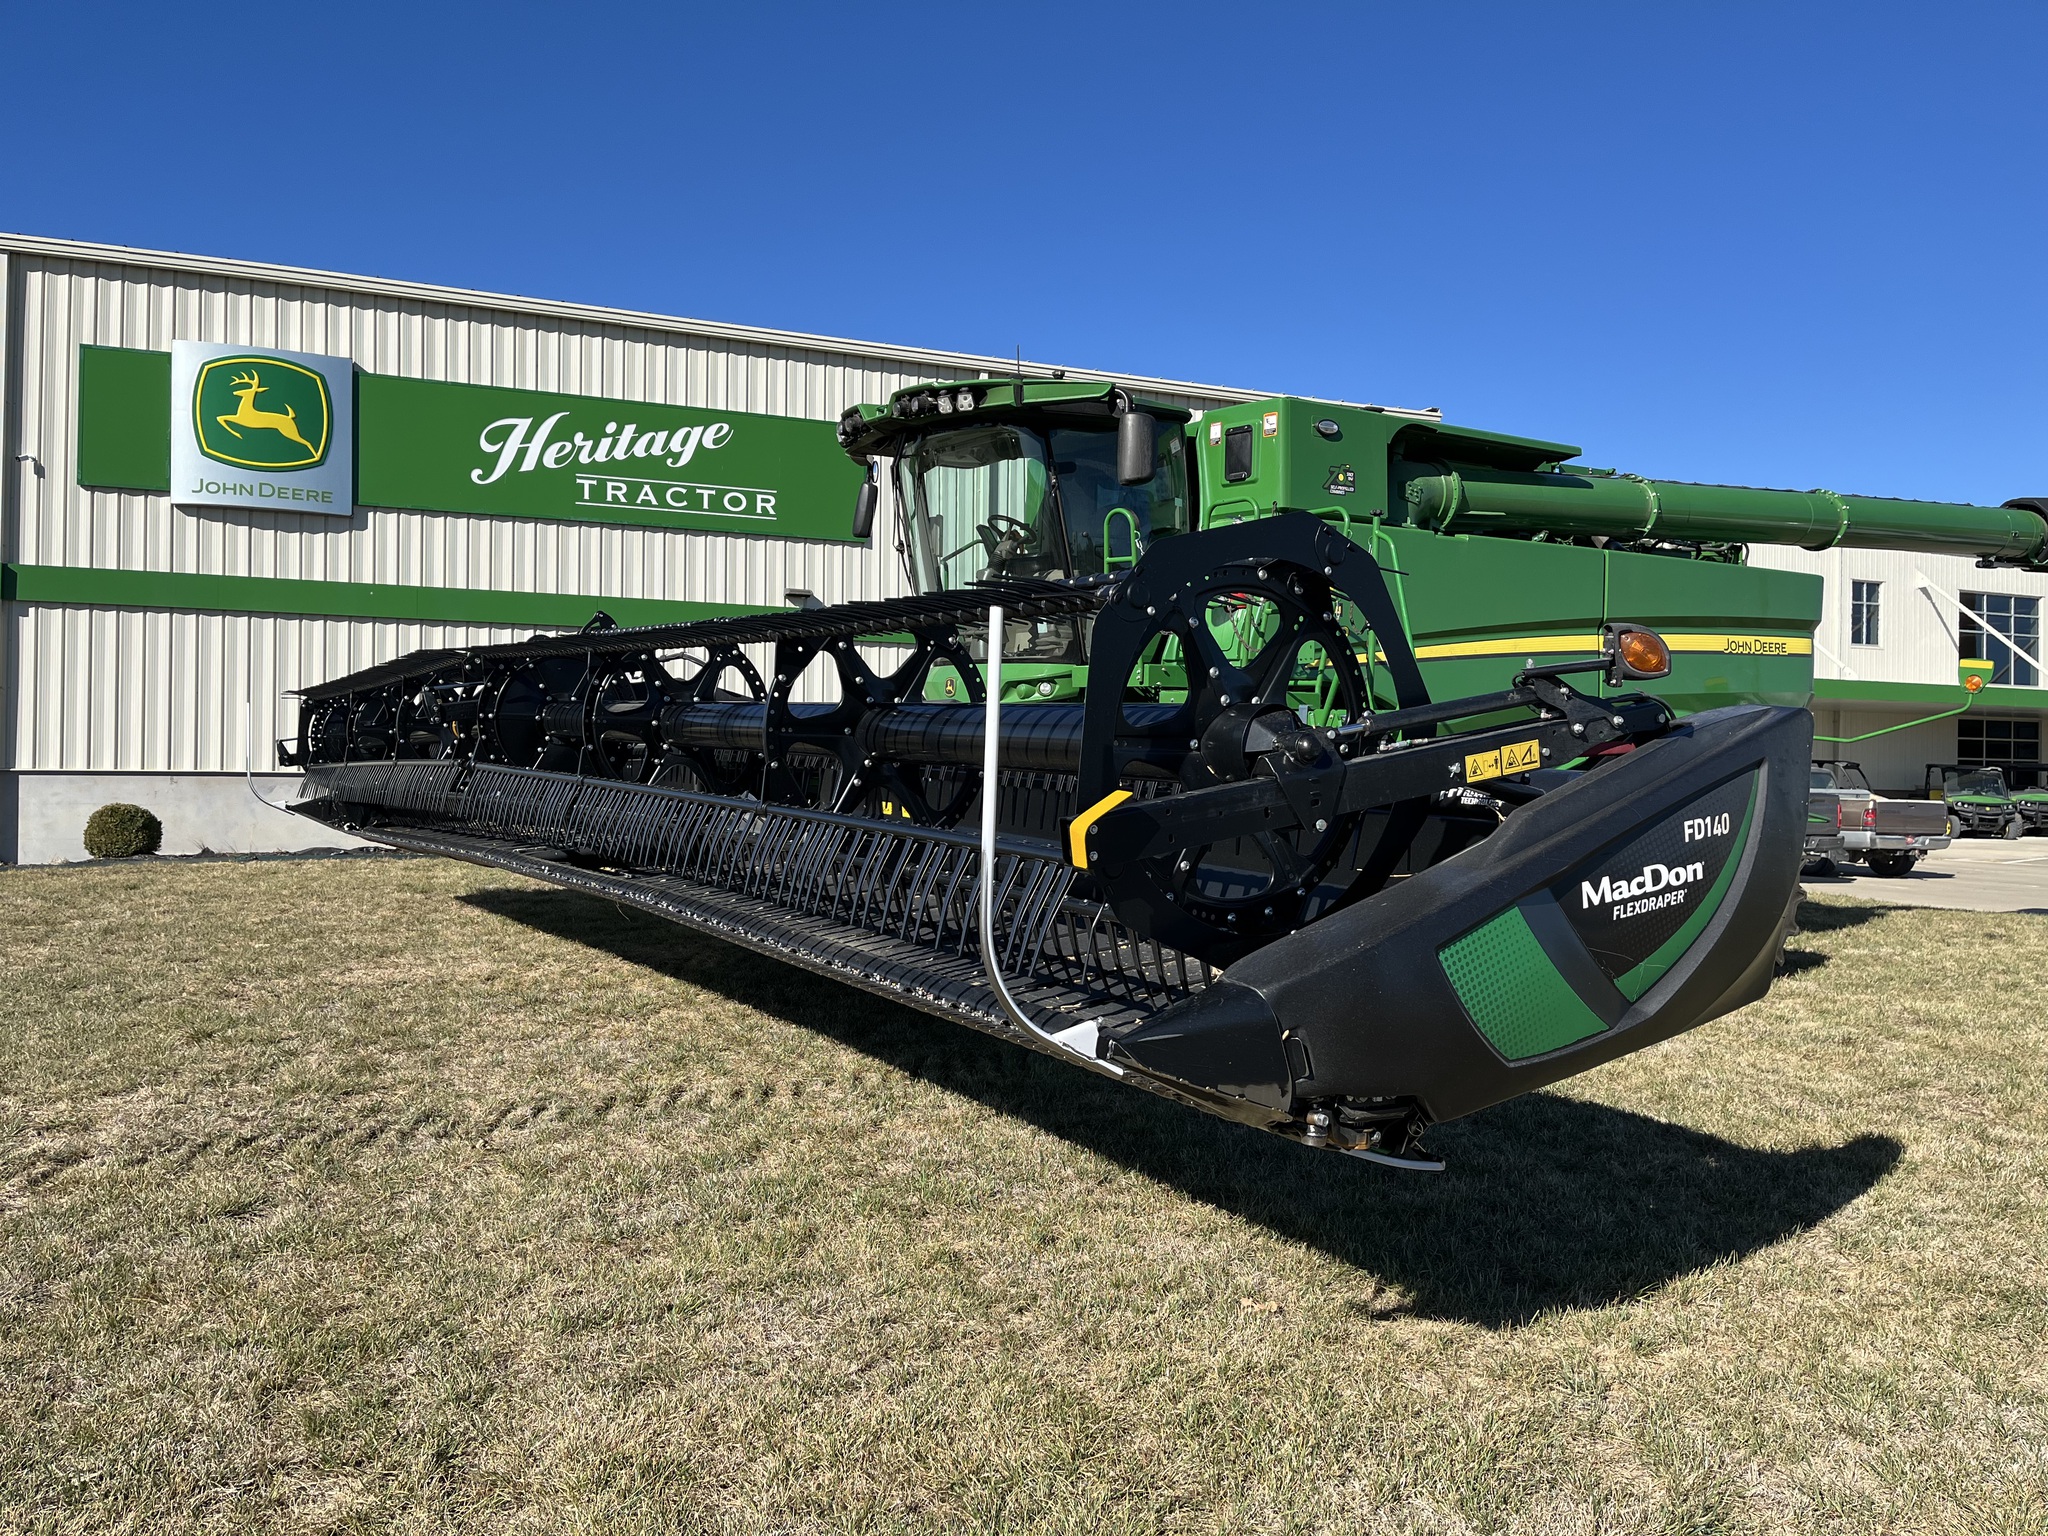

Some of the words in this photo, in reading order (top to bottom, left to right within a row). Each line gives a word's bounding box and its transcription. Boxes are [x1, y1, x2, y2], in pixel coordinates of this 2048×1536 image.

[470, 411, 734, 485] Heritage
[191, 478, 254, 496] JOHN
[258, 482, 333, 503] DEERE
[576, 478, 777, 516] TRACTOR
[1724, 638, 1752, 652] JOHN
[1754, 639, 1787, 653] DEERE
[1683, 812, 1730, 843] FD140
[1581, 861, 1704, 909] MacDon
[1612, 890, 1686, 920] FLEXDRAPER
